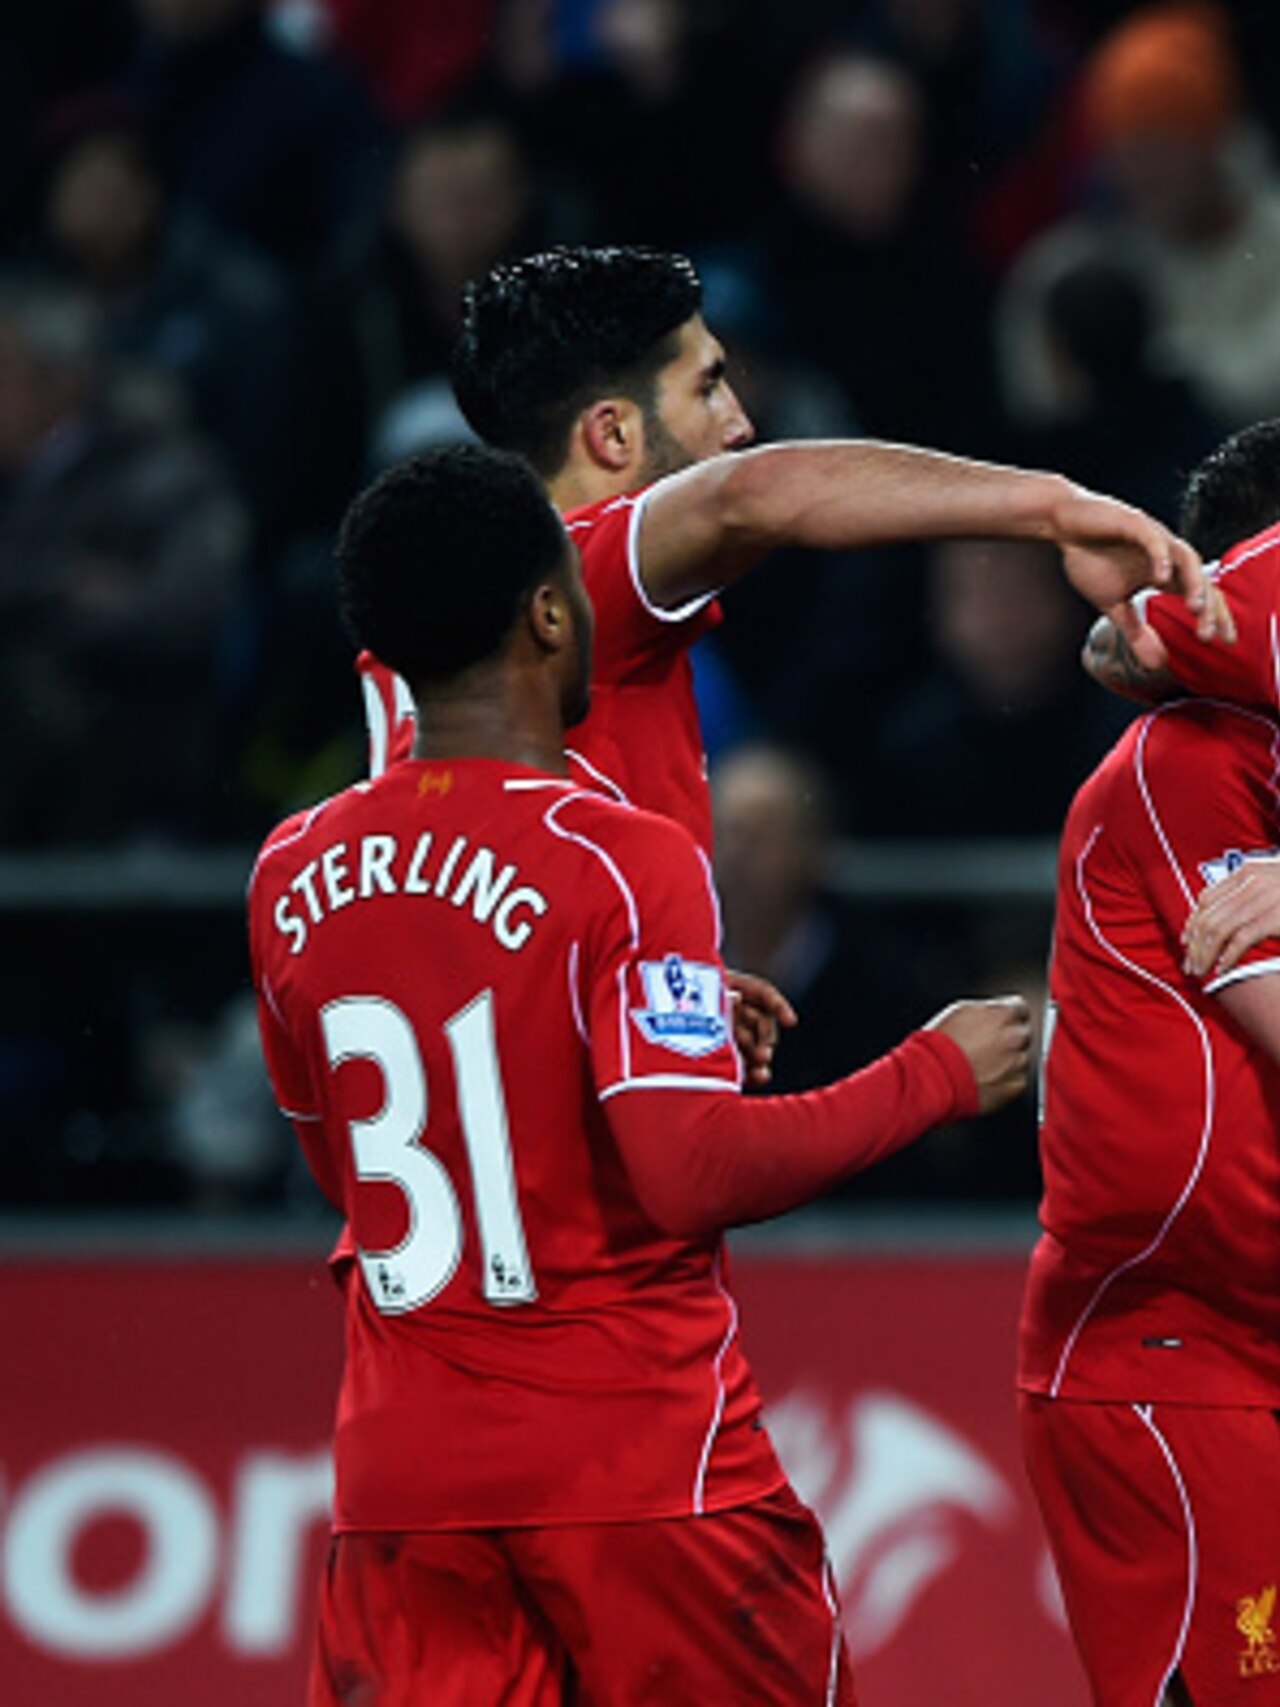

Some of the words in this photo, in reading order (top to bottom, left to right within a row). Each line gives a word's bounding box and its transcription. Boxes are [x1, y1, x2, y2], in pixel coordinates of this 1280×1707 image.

[274, 832, 549, 955] STERLING
[320, 987, 539, 1316] 31
[0, 1442, 337, 1660] or
